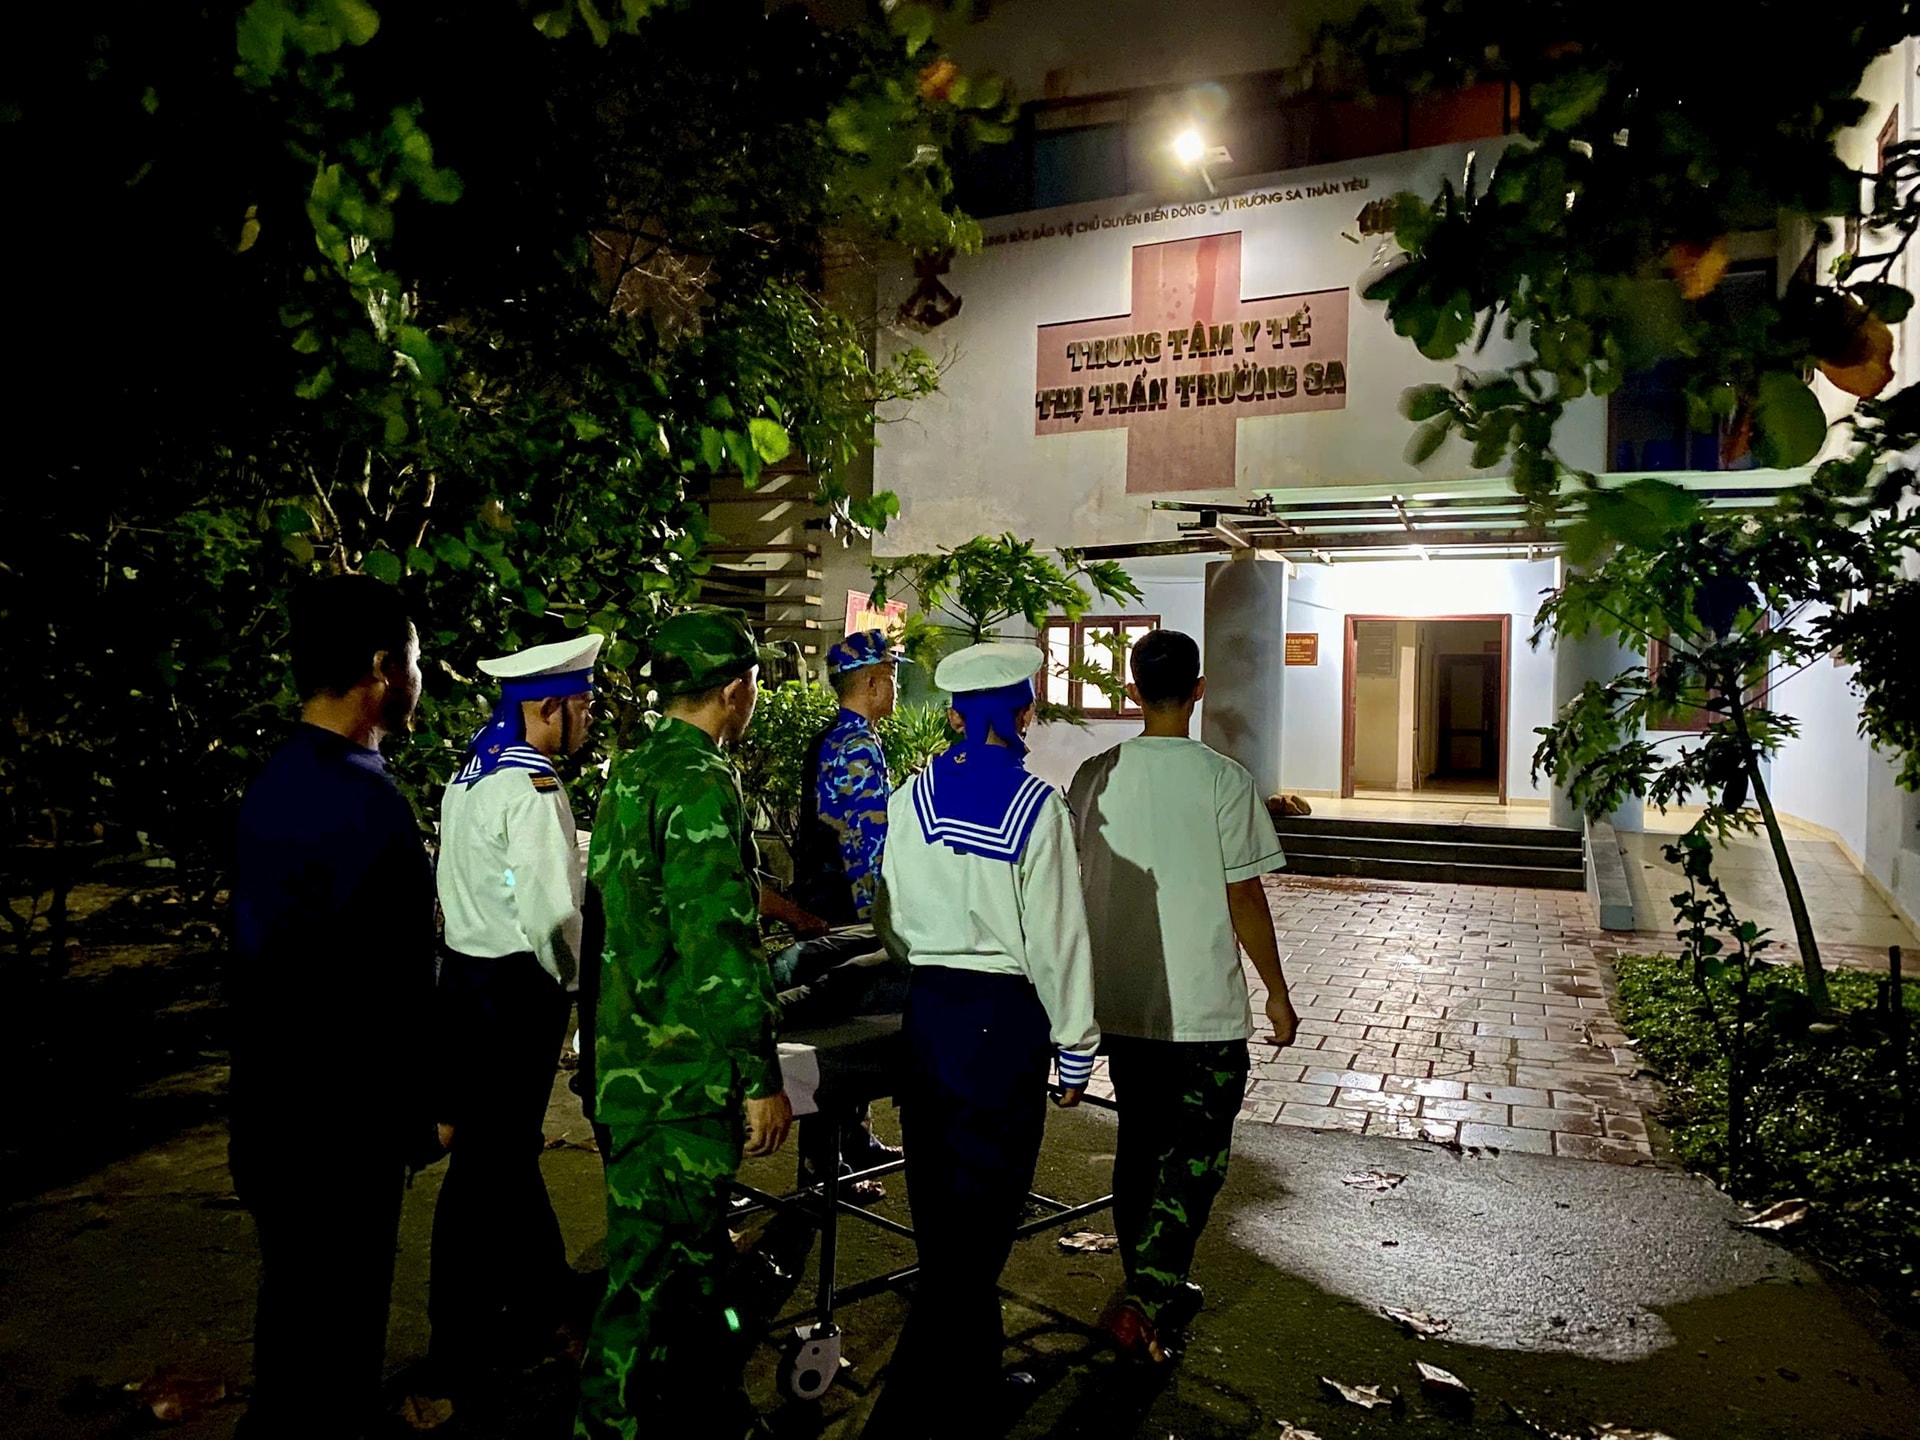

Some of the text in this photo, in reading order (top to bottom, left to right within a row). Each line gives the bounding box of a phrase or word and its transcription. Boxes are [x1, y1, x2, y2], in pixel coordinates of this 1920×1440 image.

[1076, 215, 1100, 233] CHỦ
[1171, 203, 1207, 220] ĐÔNG
[1219, 197, 1230, 212] VÌ
[1285, 188, 1303, 201] SA
[1306, 181, 1340, 198] THÂN
[1342, 176, 1369, 193] YÊU
[1067, 303, 1311, 372] TRUNG TÂM Y TẾ
[1036, 359, 1346, 423] THỊ TRẤN TRƯỜNG SA
